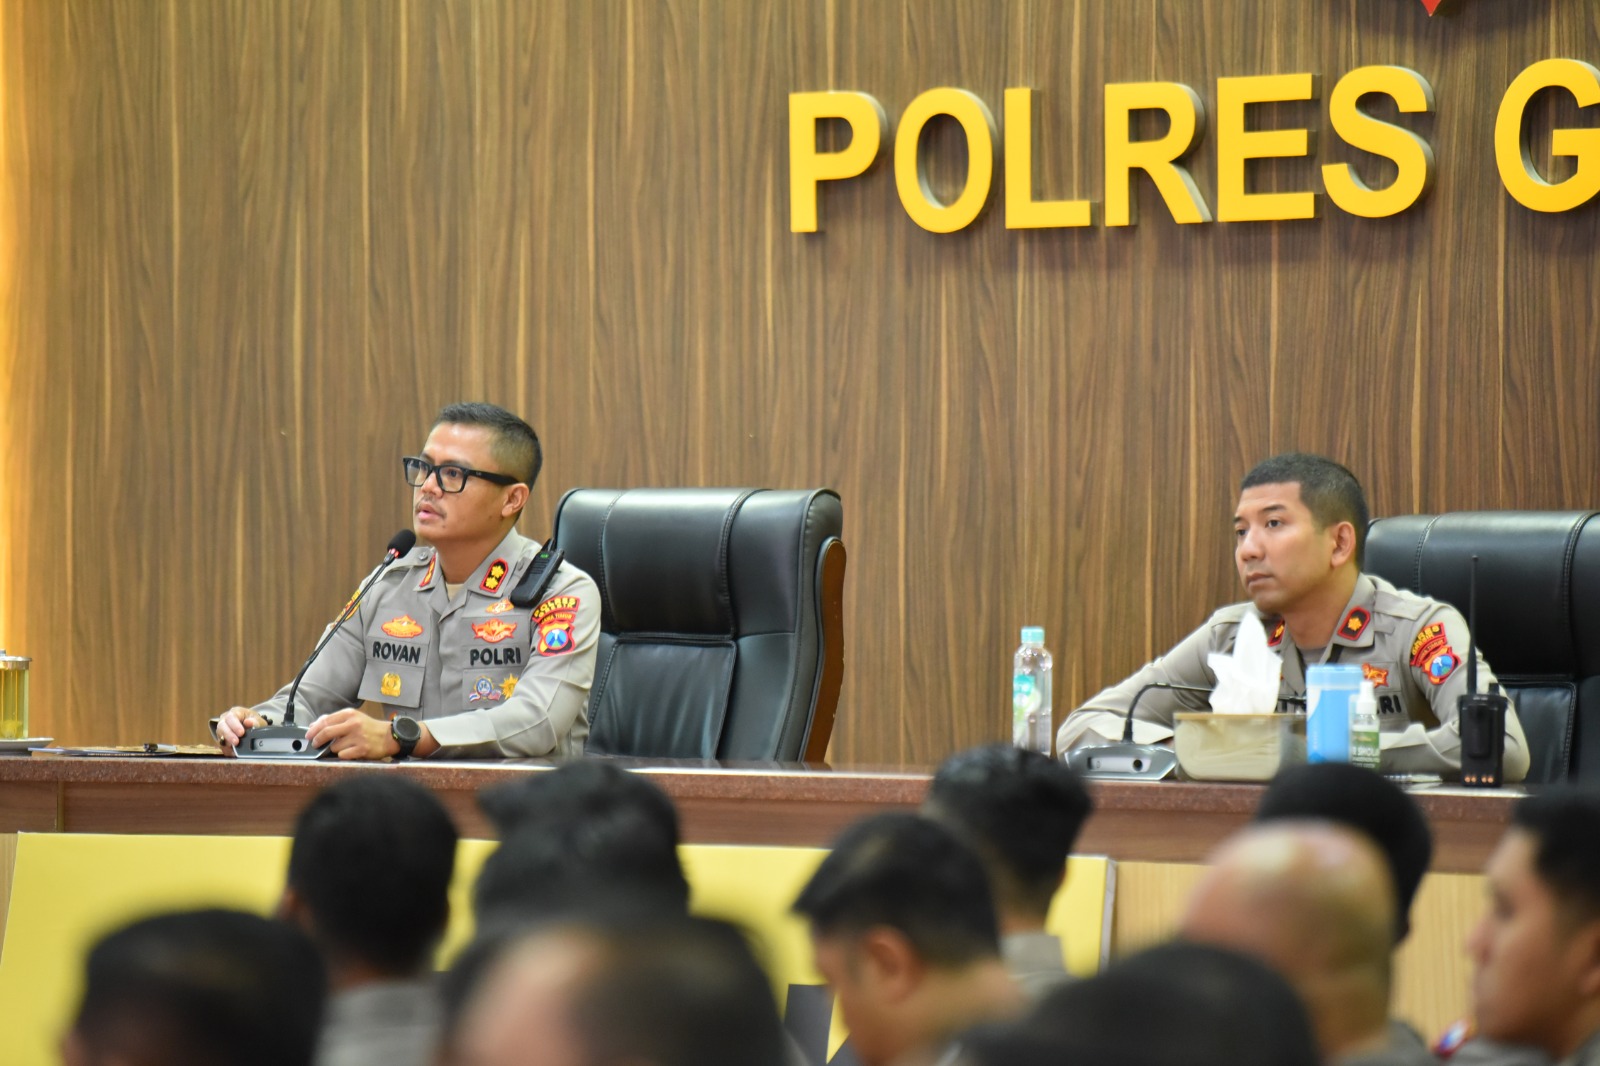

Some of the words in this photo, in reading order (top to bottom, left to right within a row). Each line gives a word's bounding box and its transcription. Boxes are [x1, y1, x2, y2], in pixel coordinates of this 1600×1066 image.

[789, 65, 1432, 233] POLRES
[373, 641, 421, 664] ROVAN
[470, 647, 521, 666] POLRI
